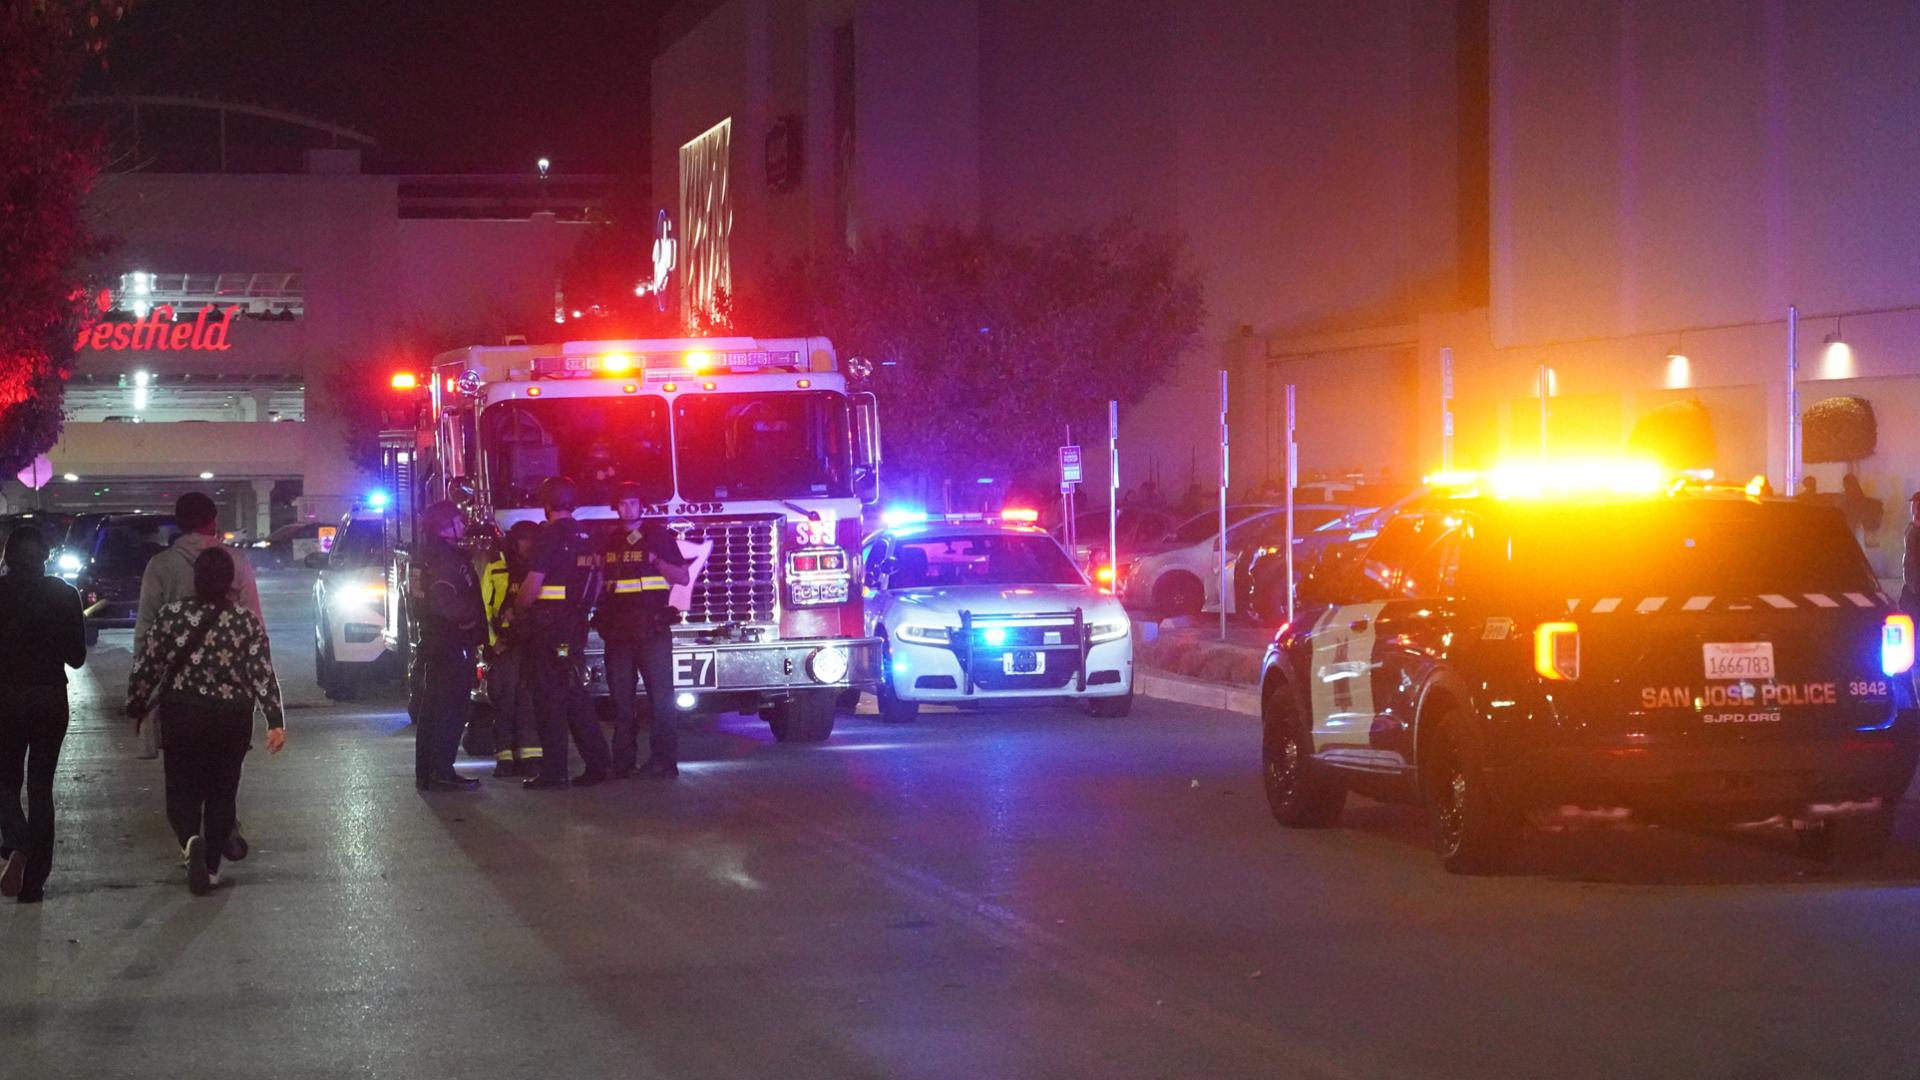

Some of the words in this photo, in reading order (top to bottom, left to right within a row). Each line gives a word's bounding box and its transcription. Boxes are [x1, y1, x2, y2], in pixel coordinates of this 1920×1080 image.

[641, 504, 668, 515] AN
[676, 503, 724, 515] JOSE
[672, 653, 714, 686] E7
[1710, 657, 1770, 674] 1666783
[1849, 681, 1888, 695] 3842
[1641, 686, 1690, 708] SAN
[1761, 684, 1837, 705] POLICE
[1703, 711, 1781, 723] SJPD.ORG
